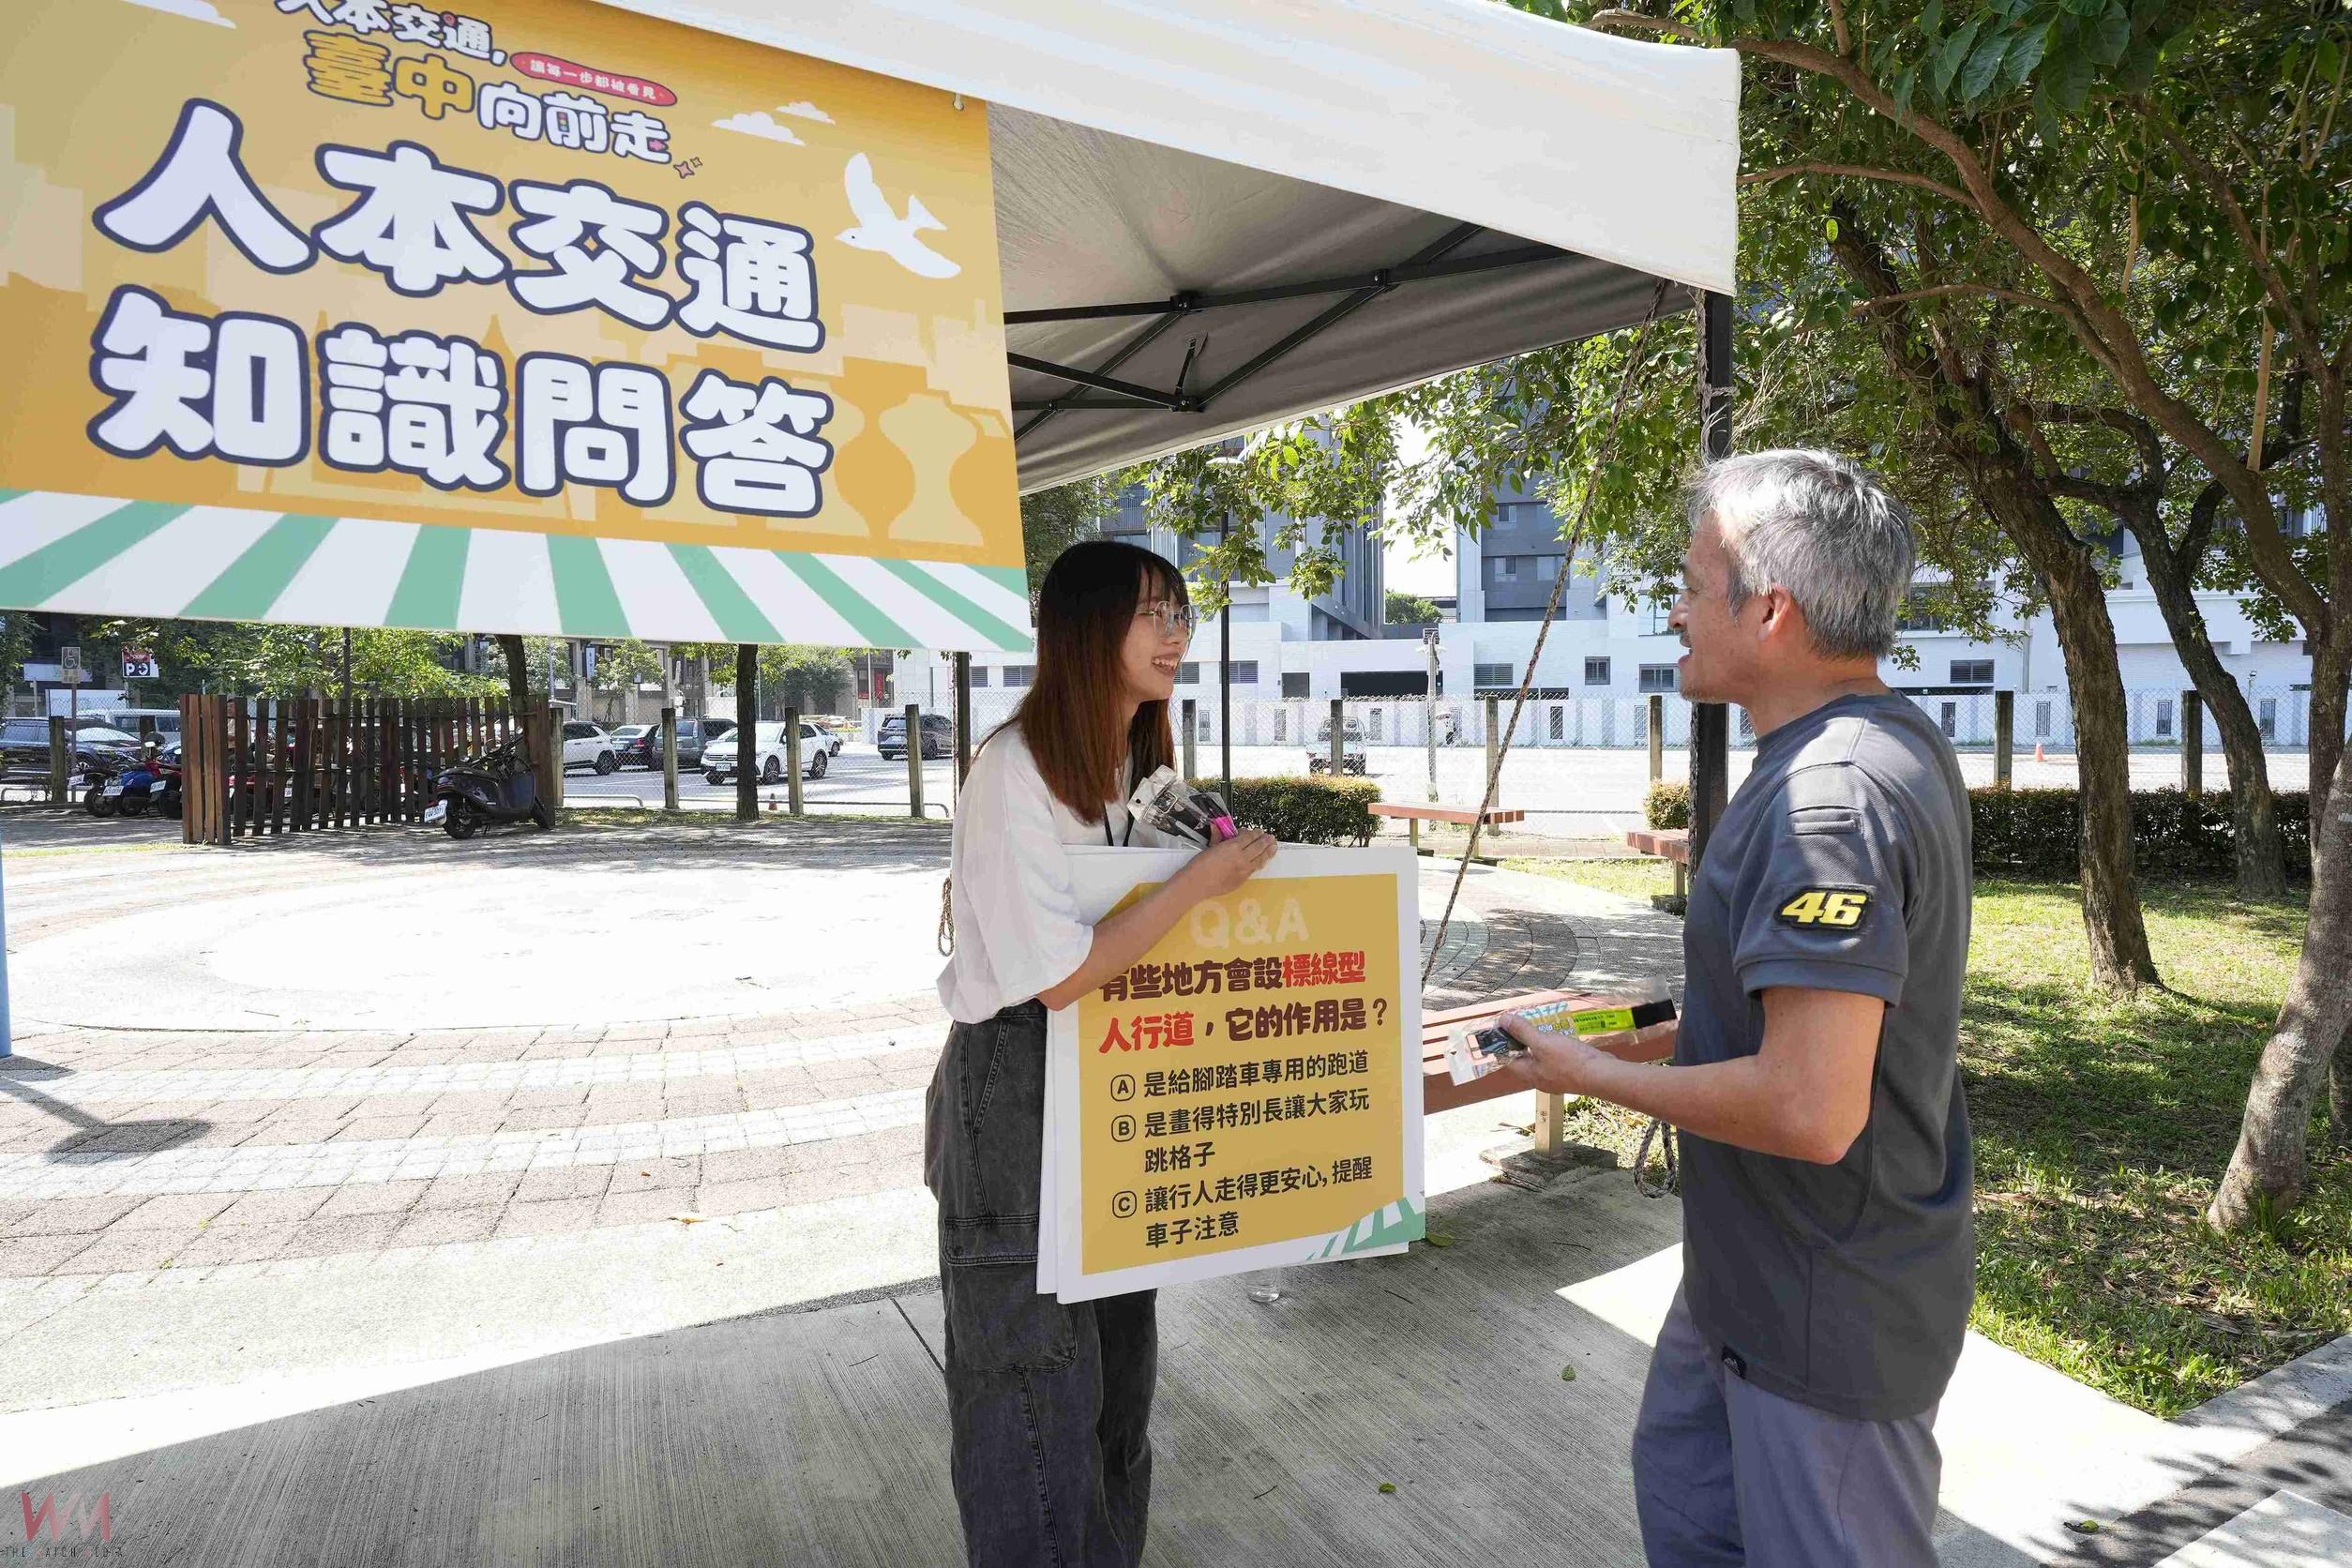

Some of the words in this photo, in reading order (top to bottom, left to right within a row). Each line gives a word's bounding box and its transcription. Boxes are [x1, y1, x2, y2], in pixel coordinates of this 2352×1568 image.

[303, 30, 672, 163] 臺中向前走
[92, 98, 826, 354] 人本交通
[86, 283, 835, 519] 知識問答
[1189, 895, 1310, 949] Q&A
[1781, 891, 1868, 926] 46
[1099, 950, 1366, 1002] 有些地方會設標線型
[1143, 1049, 1369, 1098] 是給腳踏車專用的跑道
[1144, 1088, 1370, 1138] 是畫得特別長讓大家玩
[1144, 1141, 1216, 1174] 跳格子
[1146, 1211, 1239, 1249] 車子注意
